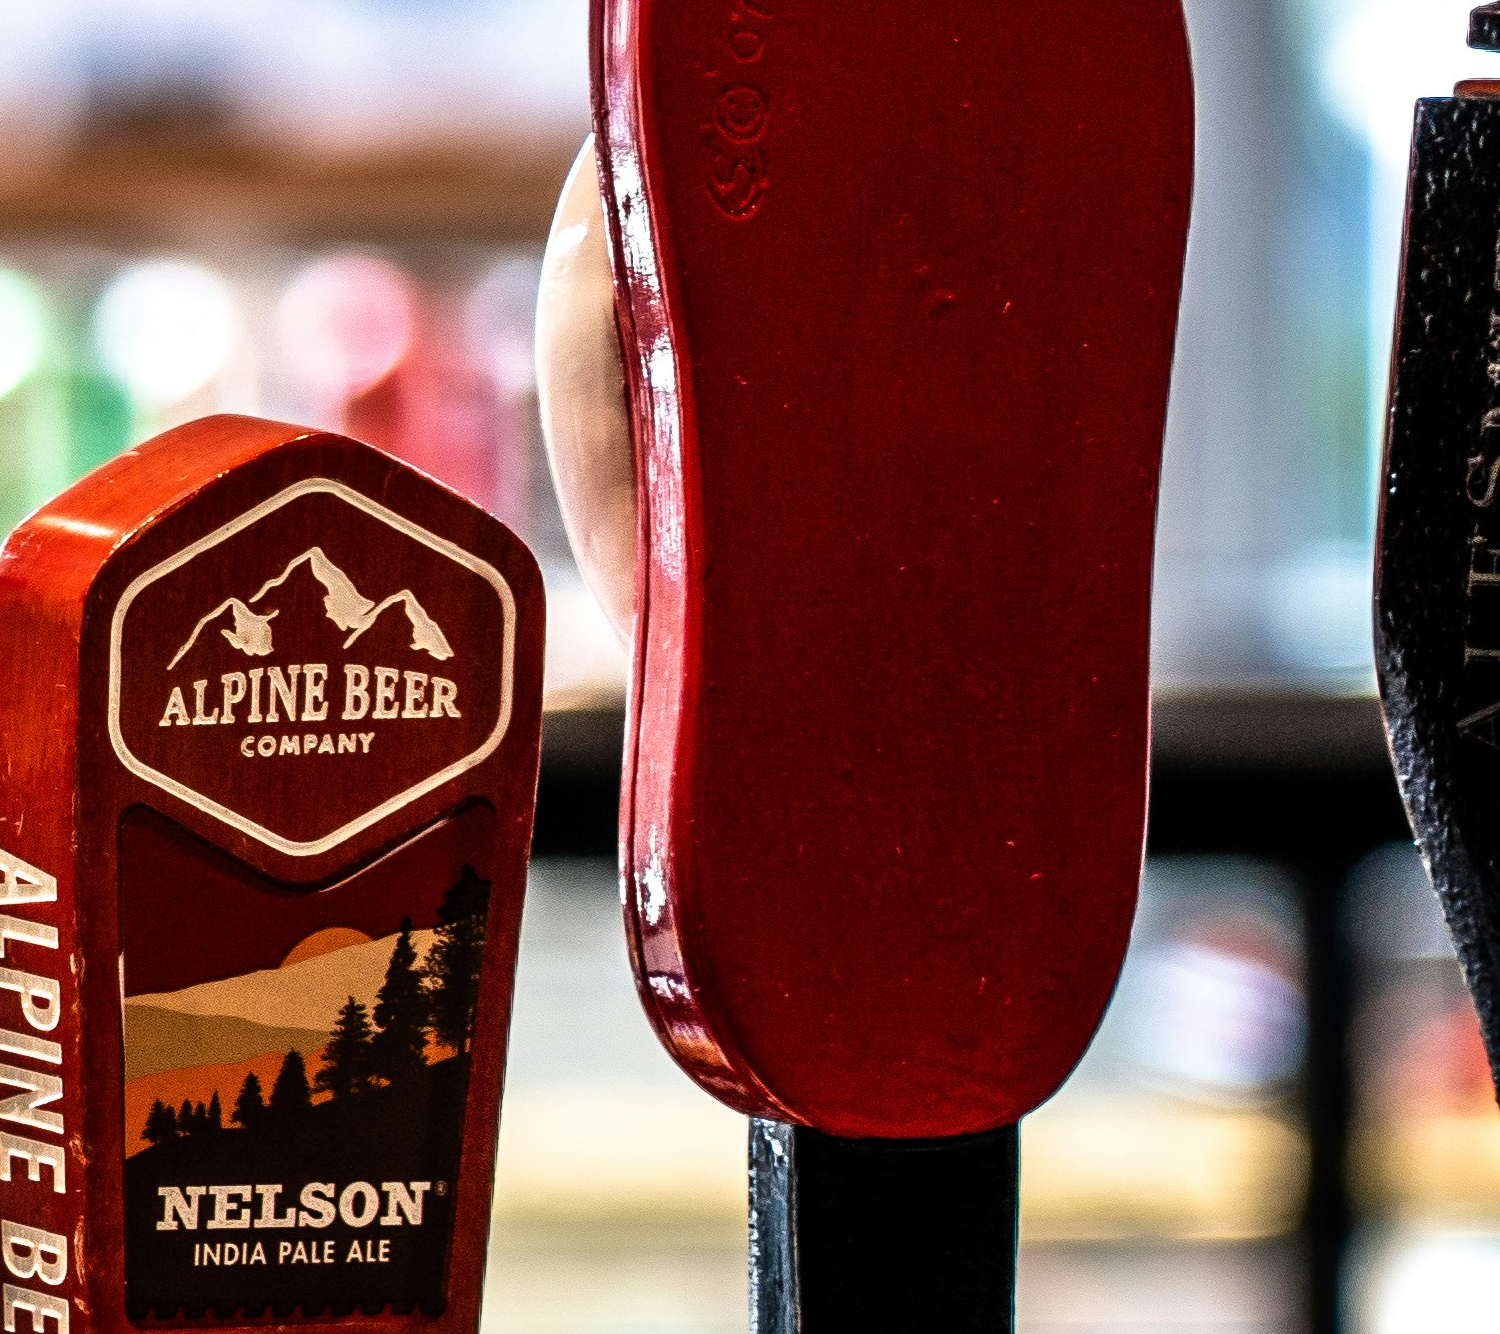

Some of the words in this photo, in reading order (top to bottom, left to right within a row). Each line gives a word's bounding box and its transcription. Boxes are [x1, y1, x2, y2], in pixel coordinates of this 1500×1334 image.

[159, 664, 329, 726] ALPINE
[341, 664, 462, 720] BEER
[240, 732, 375, 757] COMPANY
[194, 1241, 267, 1267] INDIA
[279, 1240, 336, 1264] PALE
[346, 1239, 391, 1263] ALE
